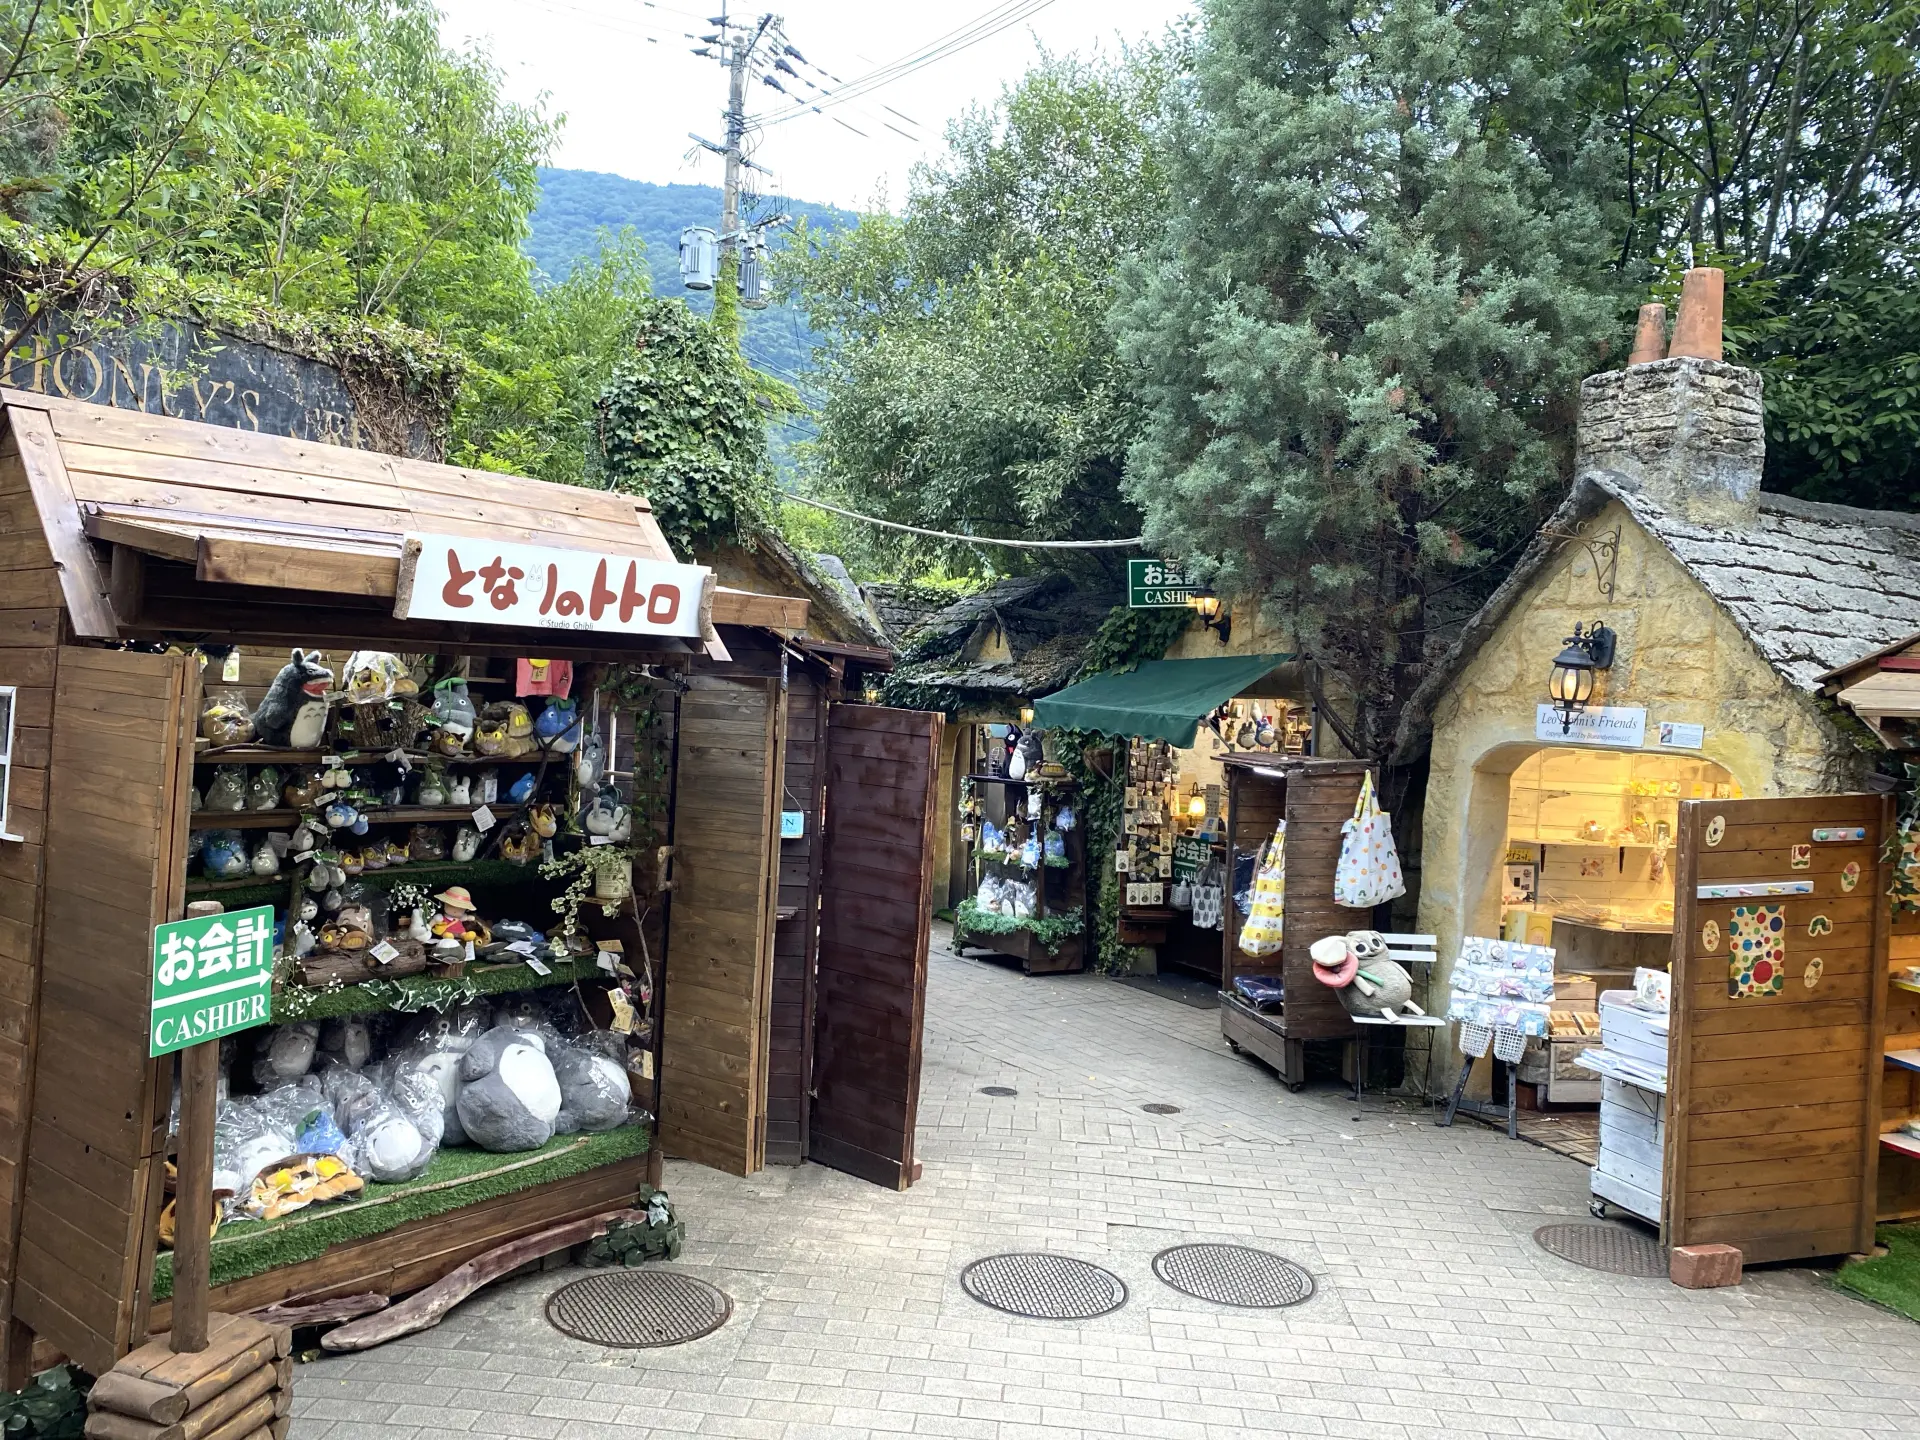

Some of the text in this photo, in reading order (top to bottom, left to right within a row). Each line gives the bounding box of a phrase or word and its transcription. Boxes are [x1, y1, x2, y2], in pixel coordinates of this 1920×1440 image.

[442, 548, 681, 624] となりのトトロ
[1144, 590, 1197, 604] CASHIE
[573, 621, 594, 630] Ghibli
[1541, 712, 1557, 724] Leo
[1598, 715, 1638, 730] Friends
[1175, 839, 1213, 862] お会計
[1174, 867, 1199, 883] CASH
[157, 914, 270, 987] お会計
[154, 993, 267, 1048] CASHIER
